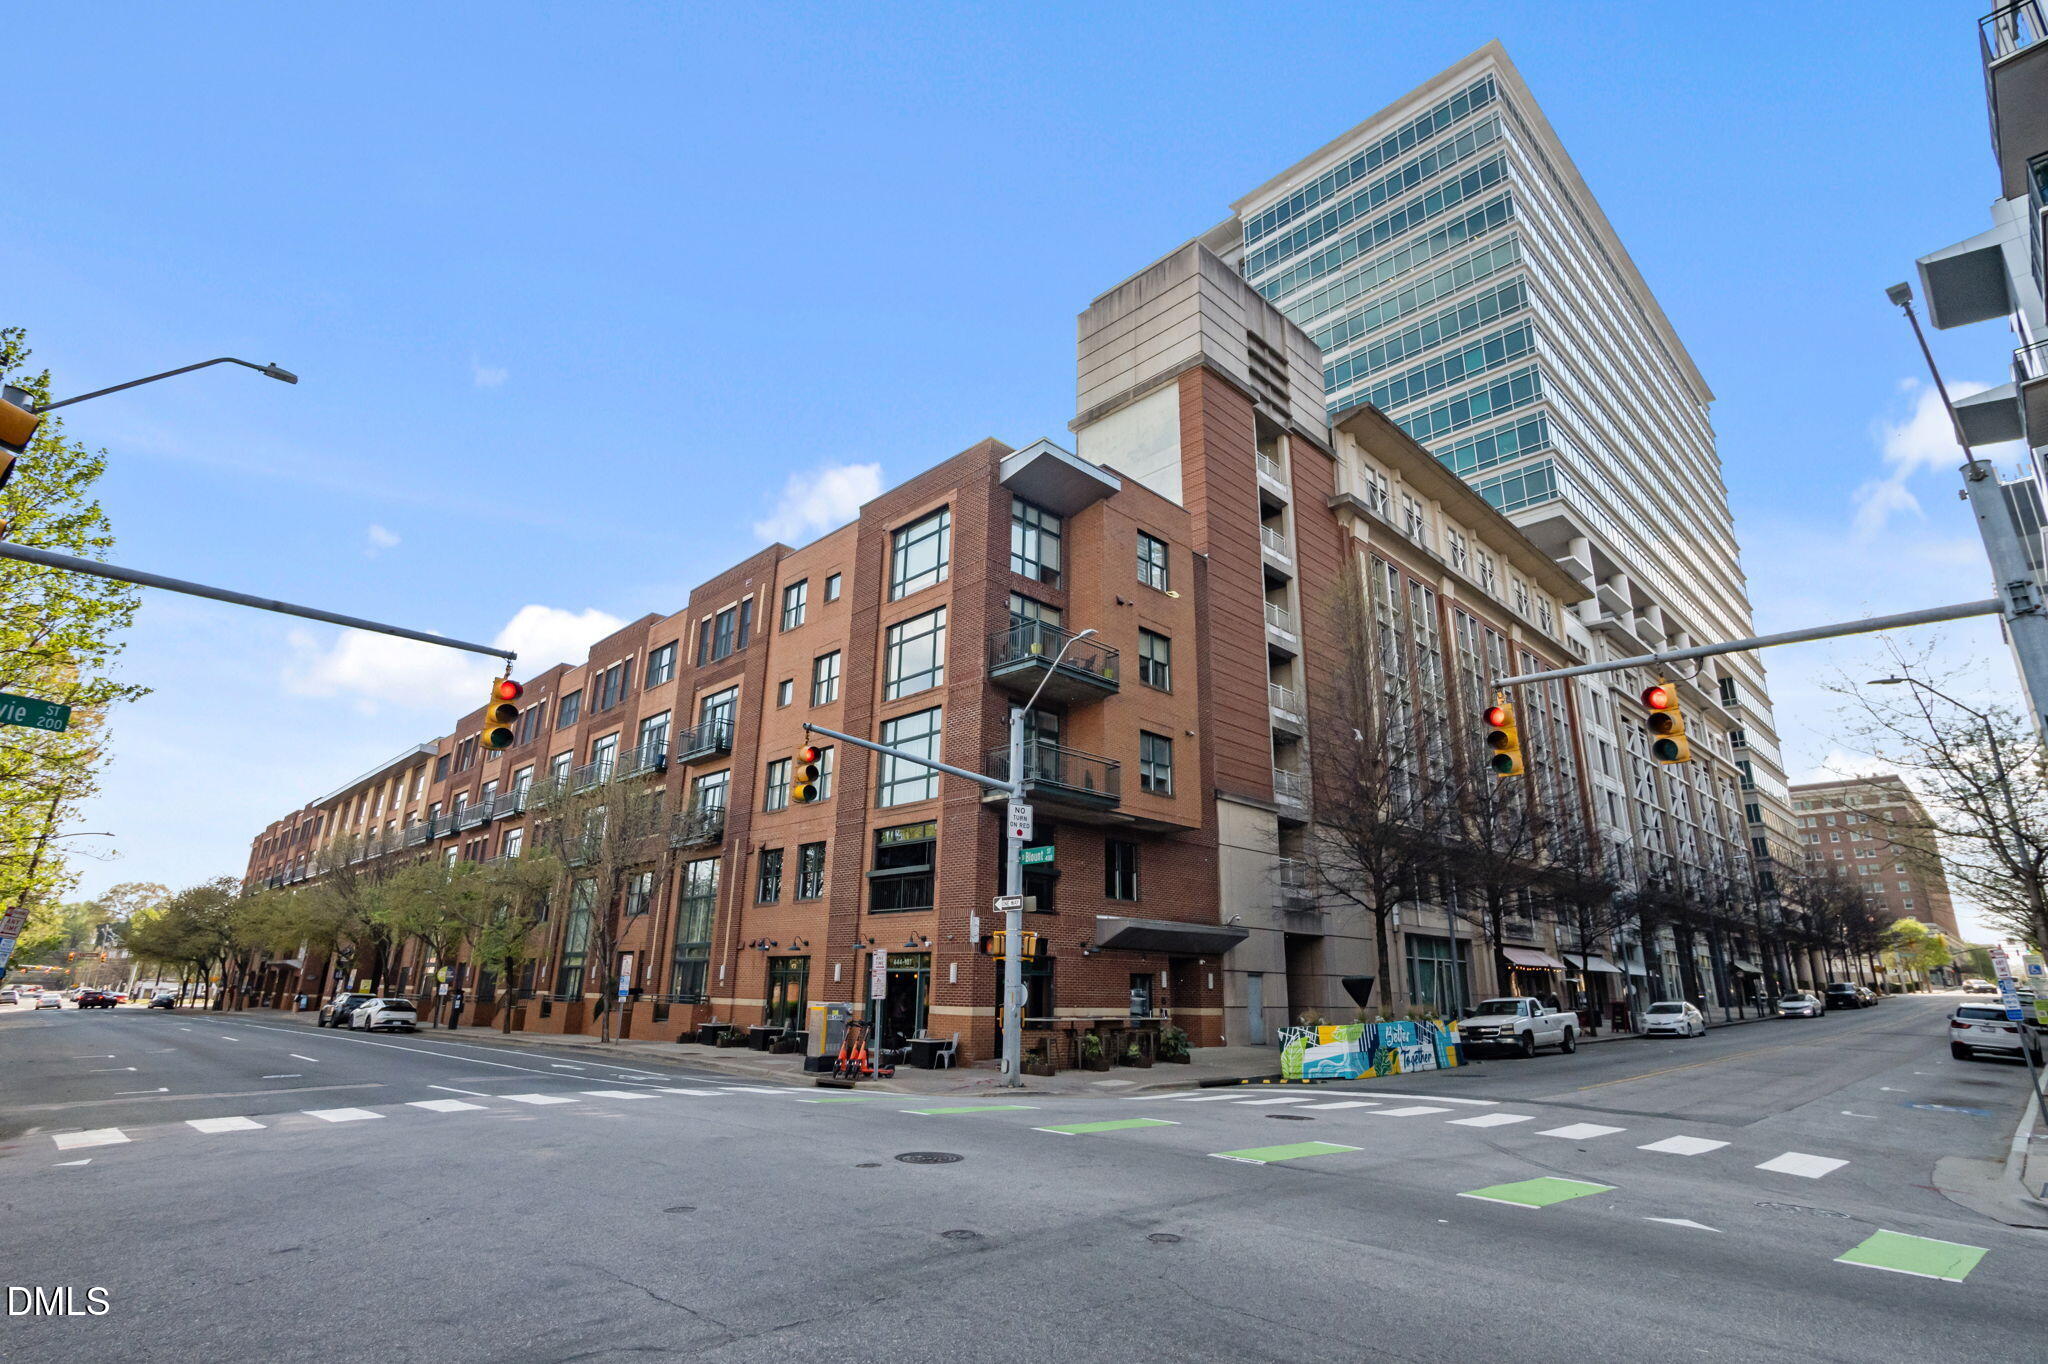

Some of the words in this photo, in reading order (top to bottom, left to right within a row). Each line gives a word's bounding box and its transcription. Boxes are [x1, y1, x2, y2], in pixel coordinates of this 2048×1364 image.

[46, 705, 61, 716] ST
[36, 716, 63, 729] 200
[1014, 806, 1026, 815] NO
[1025, 850, 1044, 862] Blount
[1385, 1024, 1410, 1047] Better
[1401, 1047, 1433, 1071] Together
